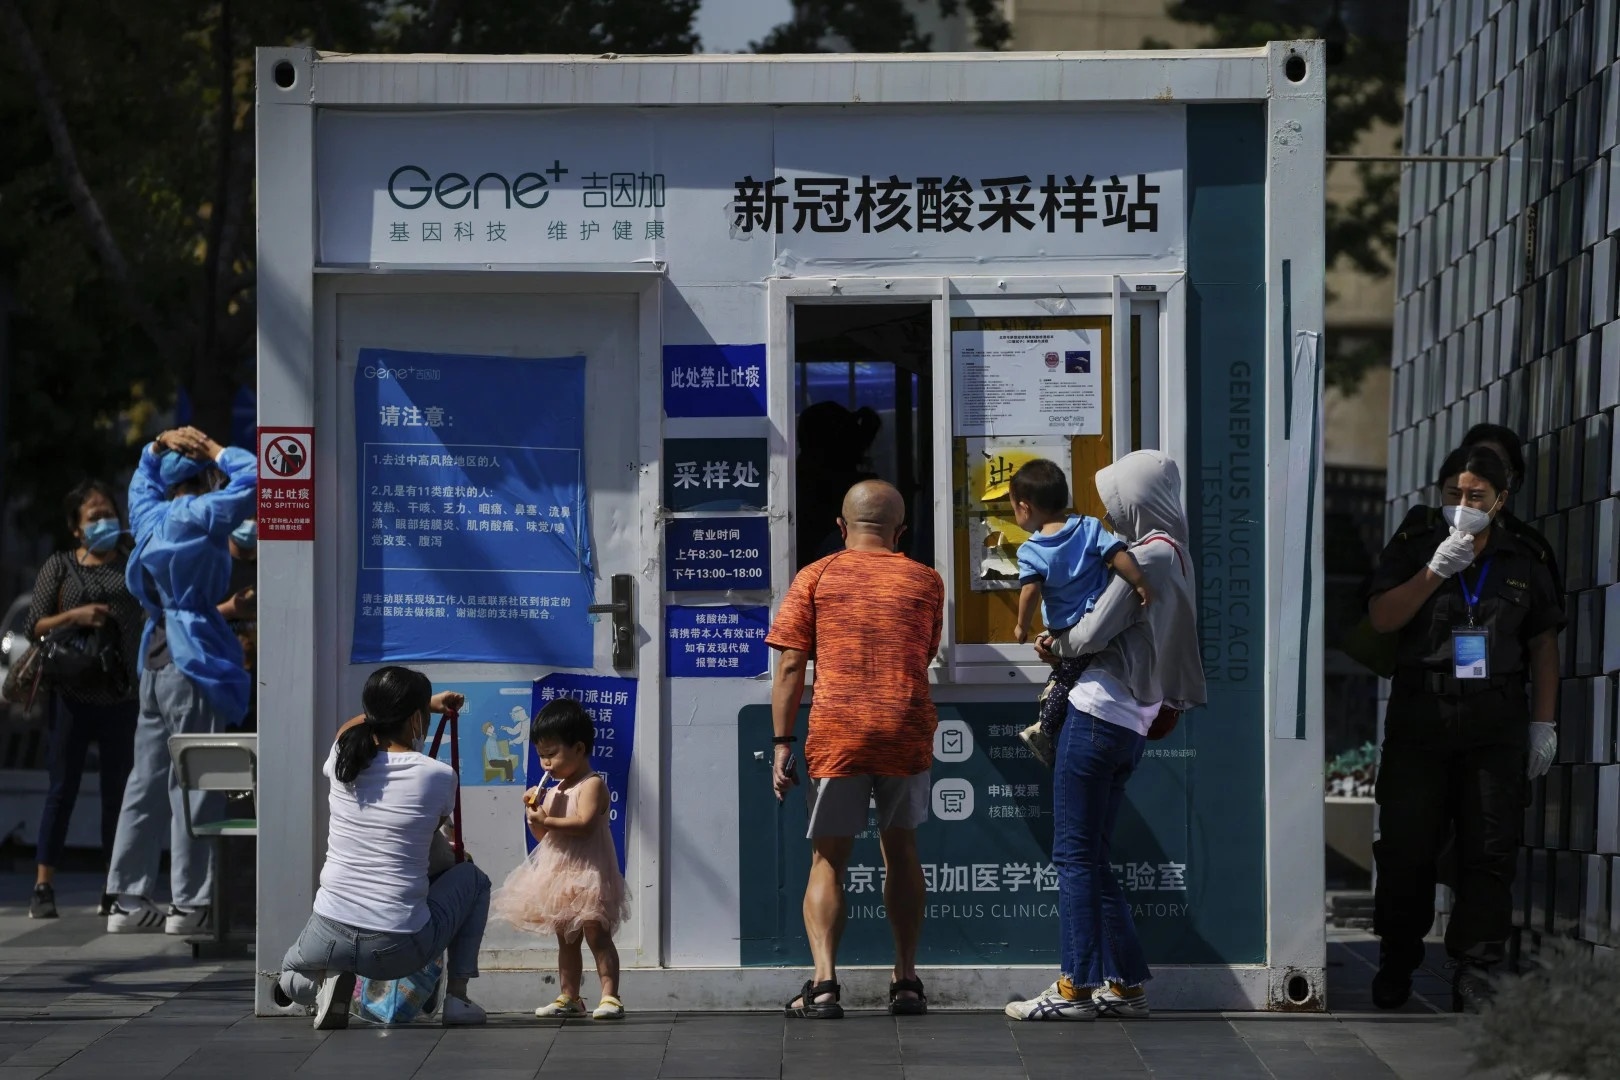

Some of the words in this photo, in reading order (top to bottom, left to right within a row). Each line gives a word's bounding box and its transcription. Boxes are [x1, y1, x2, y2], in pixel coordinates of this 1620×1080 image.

[581, 171, 665, 208] 吉因加
[733, 174, 1160, 233] 新冠核酸采样站
[389, 221, 507, 242] 基因科技
[547, 219, 665, 241] 维护健康
[671, 365, 760, 388] 此处禁止吐痰
[1229, 360, 1250, 500] GENEPLUS
[372, 454, 500, 467] 1.去过中高风险地区的人
[673, 461, 760, 489] 采样处
[261, 488, 309, 500] 禁止吐痰
[1201, 461, 1222, 568] TESTING
[372, 535, 442, 547] 觉改变、腹泻
[692, 529, 740, 541] 营业时间
[1228, 508, 1250, 616] NUCLEIC
[362, 593, 571, 607] 请主动联系现场工作人员或联系社区到指定的
[696, 613, 739, 625] 核酸检测
[669, 628, 766, 639] 请携带本人有效证件
[1201, 577, 1222, 680] STATION
[685, 643, 750, 653] 如有发现代做
[1228, 624, 1249, 682] ACID
[696, 657, 739, 668] 报警处理
[541, 687, 629, 705] 崇文门派出所
[988, 724, 1033, 737] 查询报
[988, 784, 1039, 797] 申请发票
